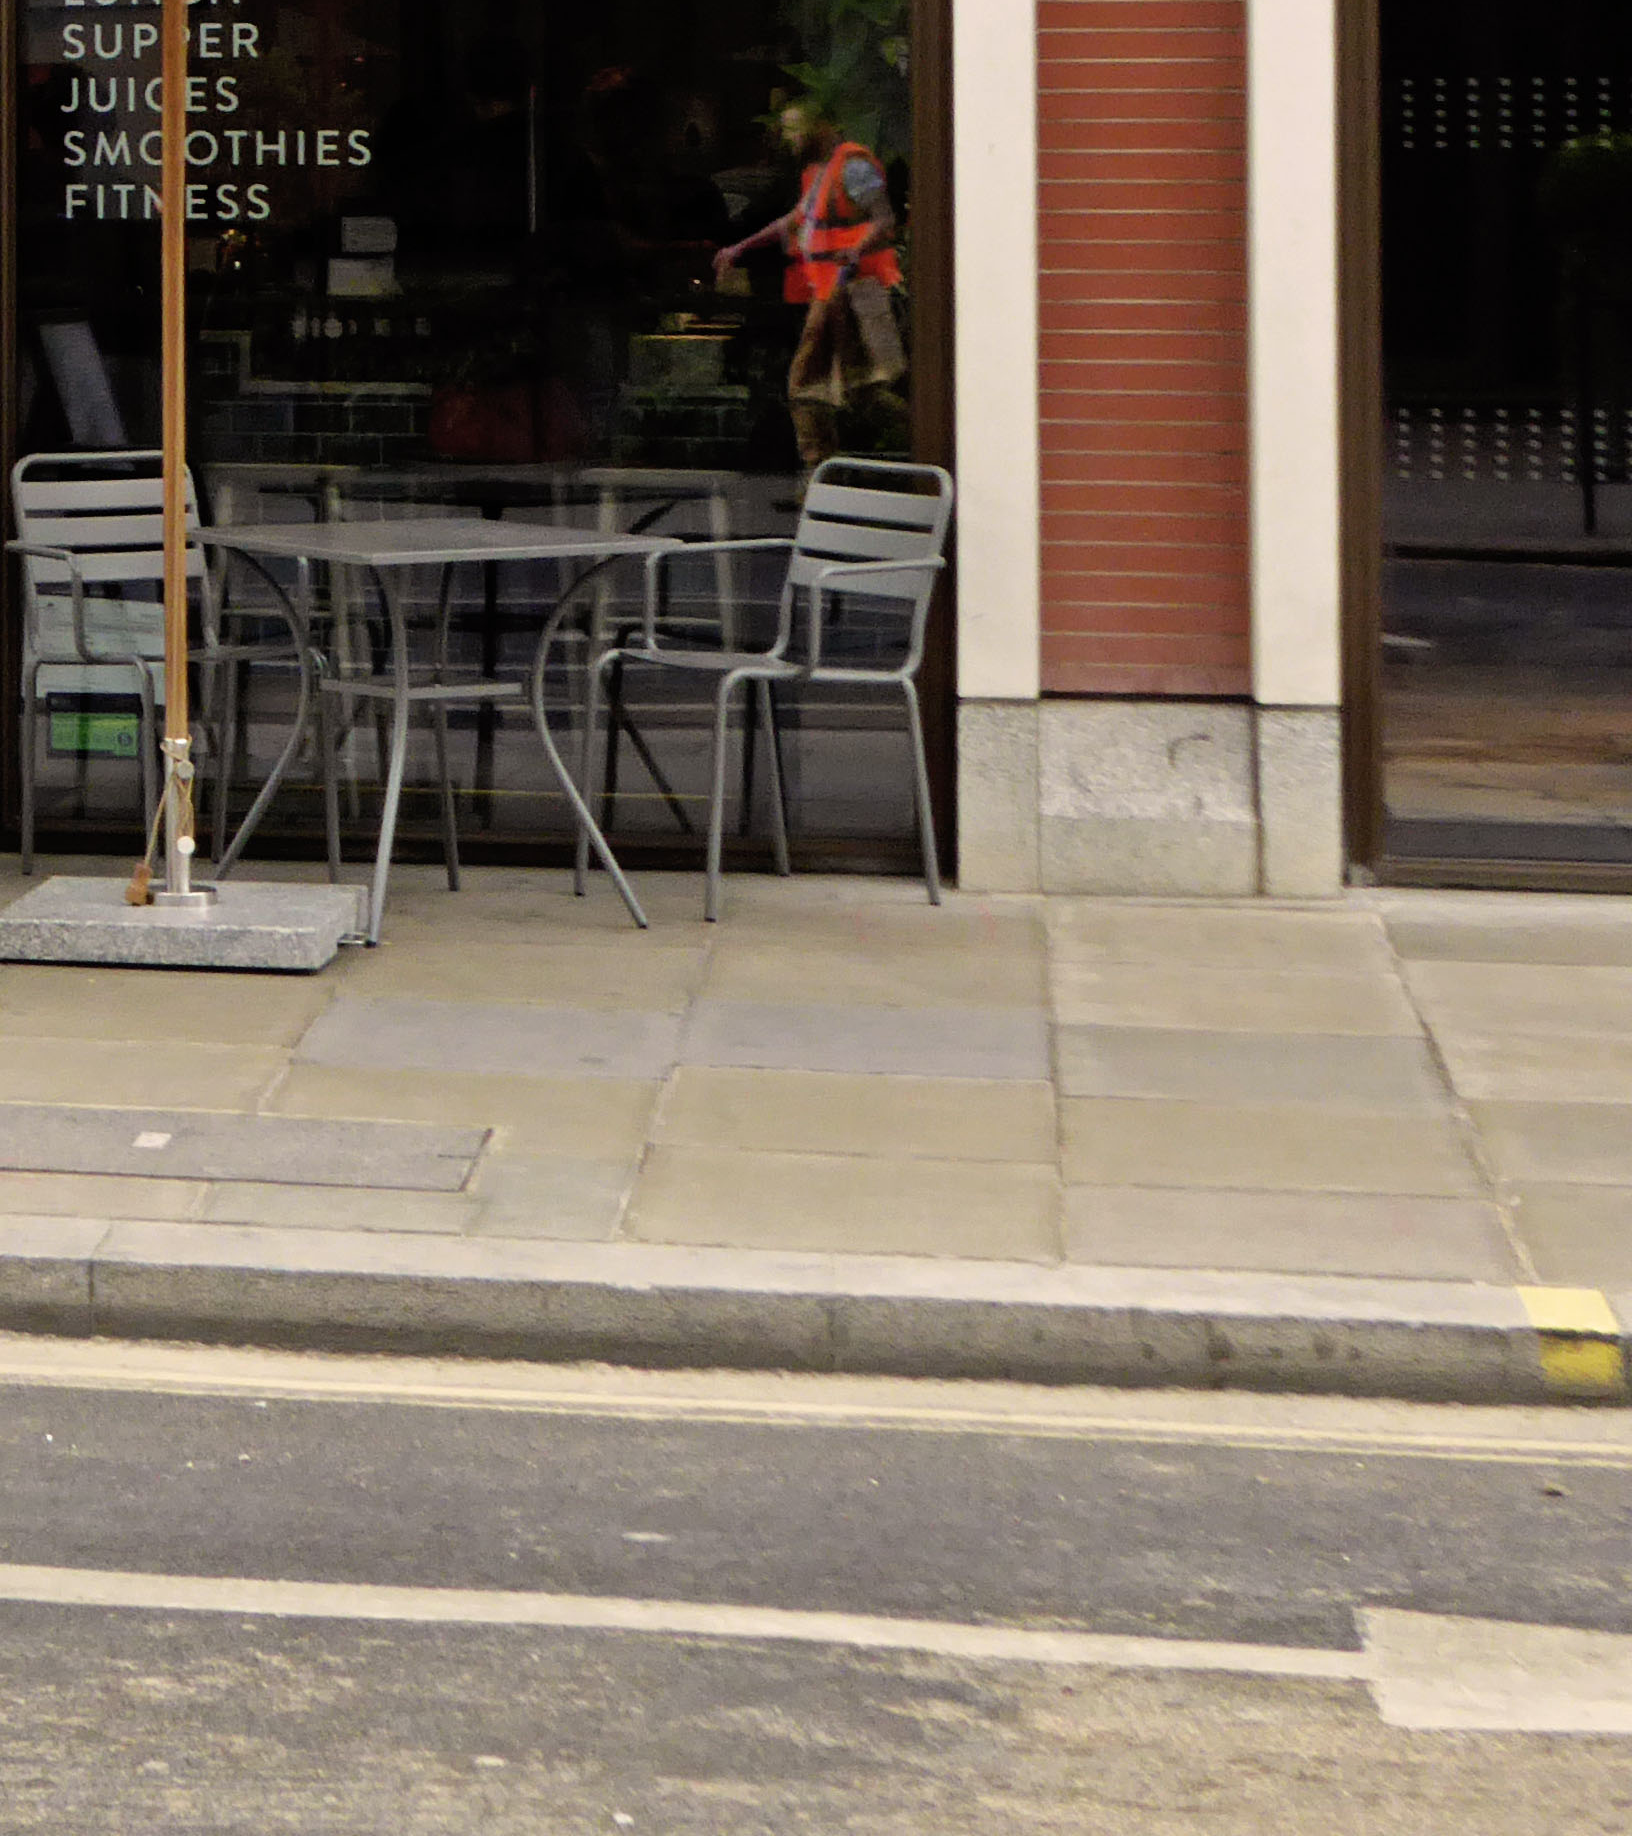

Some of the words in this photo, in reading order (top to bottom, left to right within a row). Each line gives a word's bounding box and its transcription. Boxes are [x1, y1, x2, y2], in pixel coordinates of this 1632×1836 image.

[62, 22, 260, 60] SUPER
[60, 75, 240, 114] JUICES
[63, 129, 372, 167] SMOOTHIES
[65, 183, 272, 220] FITNESS
